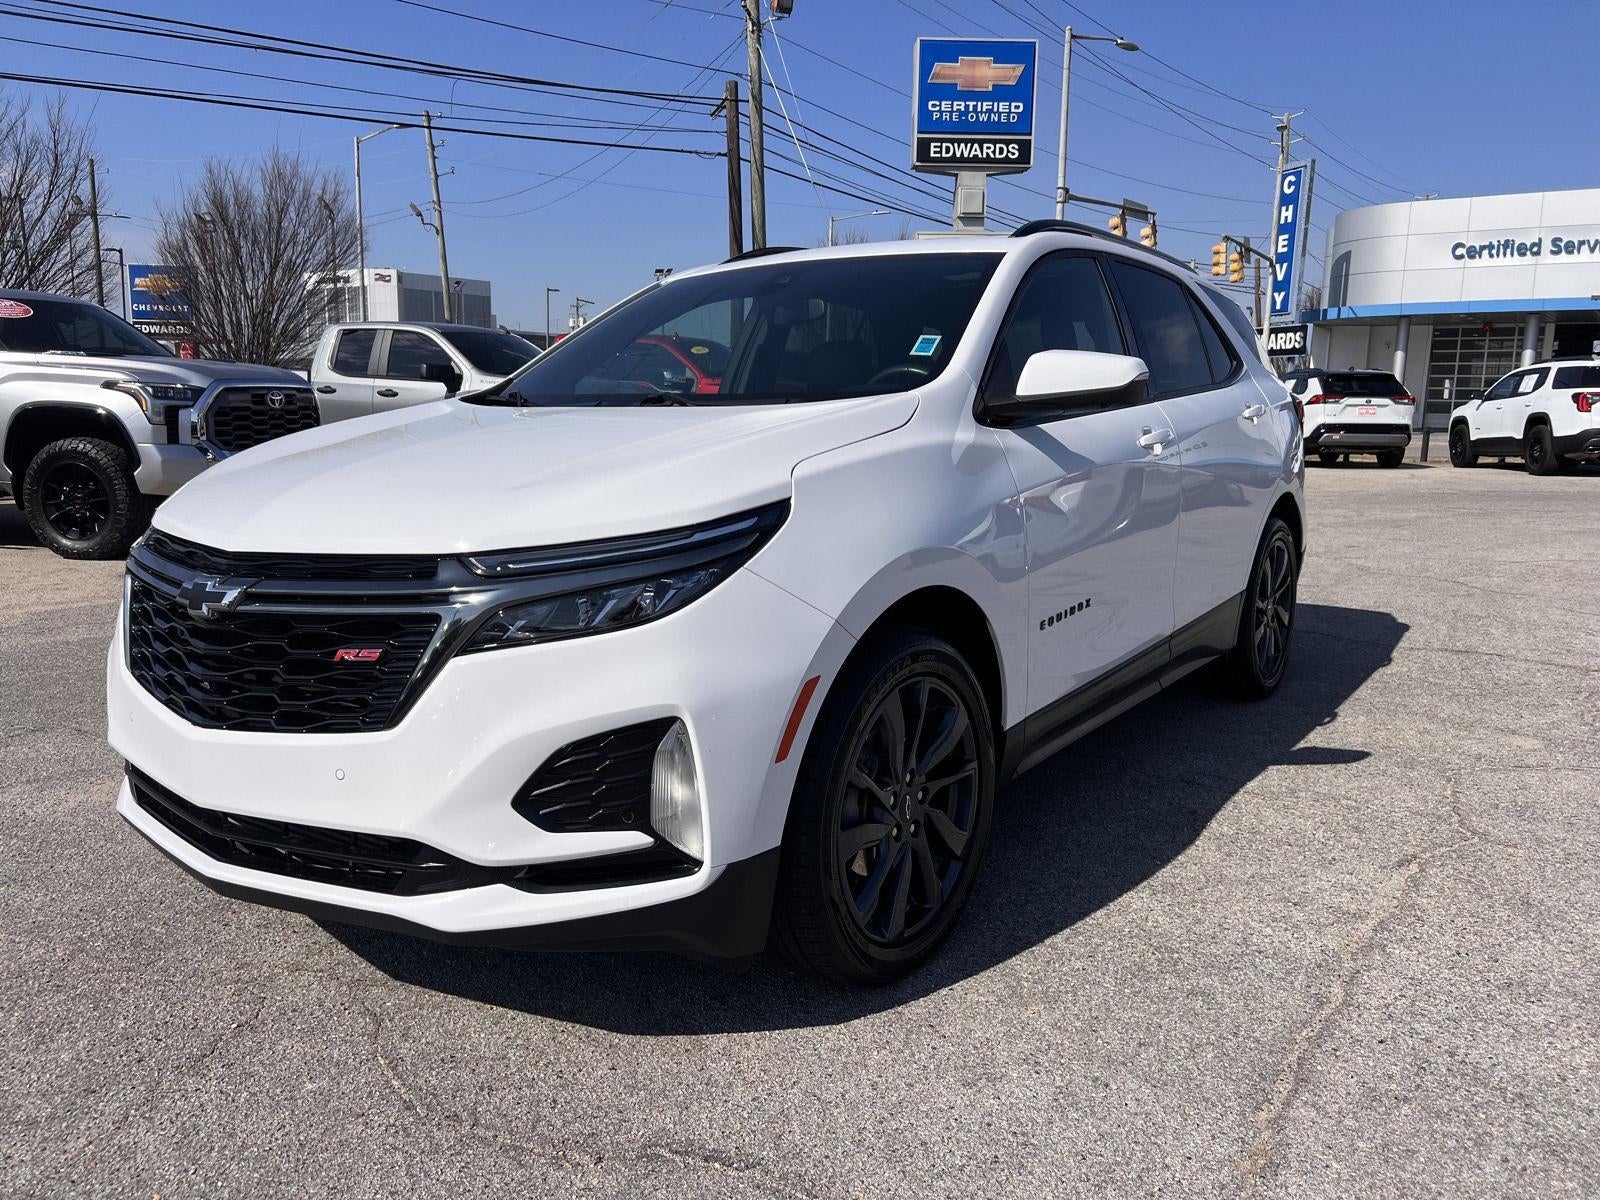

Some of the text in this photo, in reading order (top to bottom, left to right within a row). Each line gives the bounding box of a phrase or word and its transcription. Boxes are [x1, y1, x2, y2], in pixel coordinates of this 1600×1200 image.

[927, 100, 1024, 113] CERTIFIED
[932, 112, 1018, 122] PRE-OWNED
[929, 142, 1019, 159] EDWARDS
[1273, 174, 1296, 310] CHEVY
[1451, 236, 1542, 260] Certified
[1260, 331, 1304, 350] ARDS
[1039, 597, 1092, 631] EQUINOX
[333, 648, 382, 661] RS
